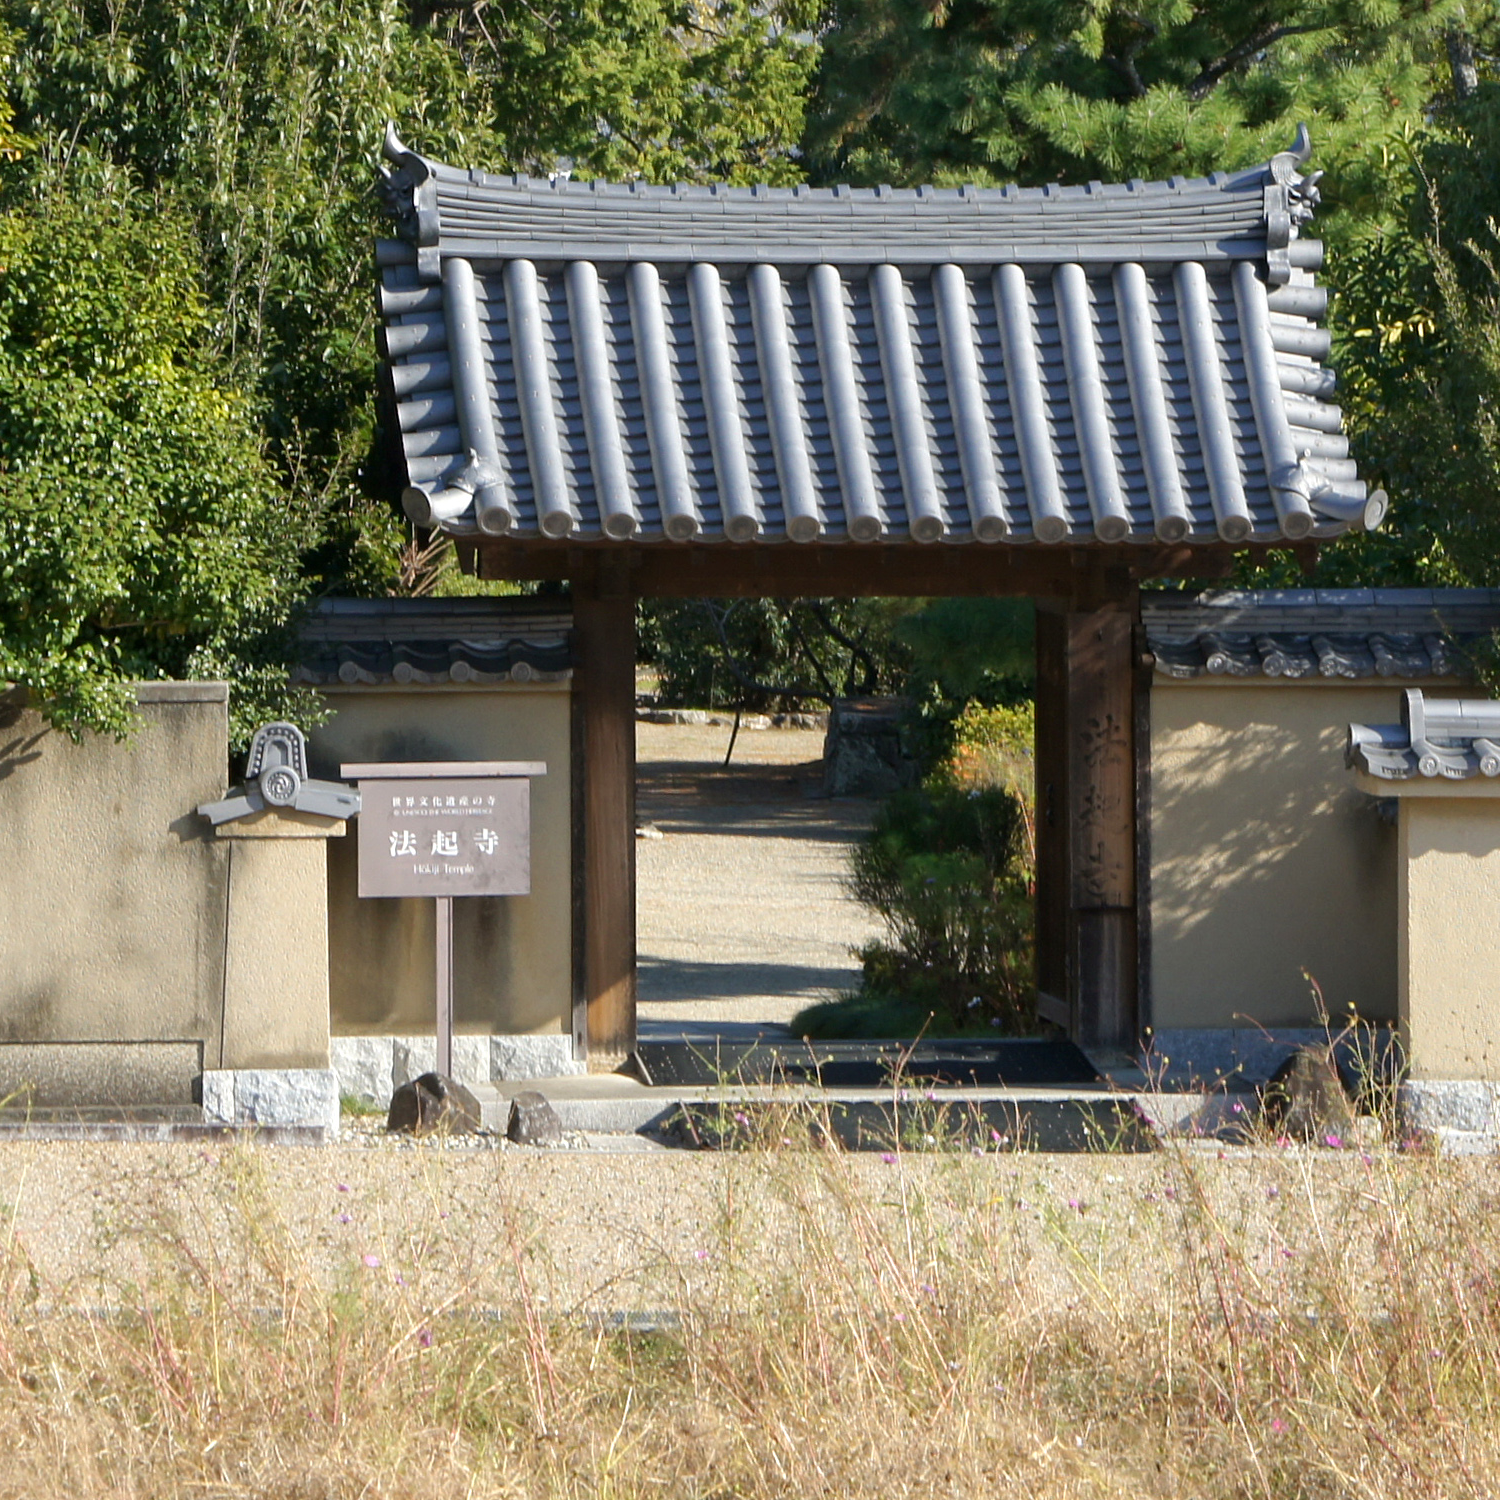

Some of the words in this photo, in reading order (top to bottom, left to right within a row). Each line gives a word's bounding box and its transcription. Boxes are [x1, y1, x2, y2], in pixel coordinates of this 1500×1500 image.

[392, 795, 496, 807] 世界文化遺産の寺
[389, 828, 499, 857] 法起寺
[444, 863, 475, 876] Temple
